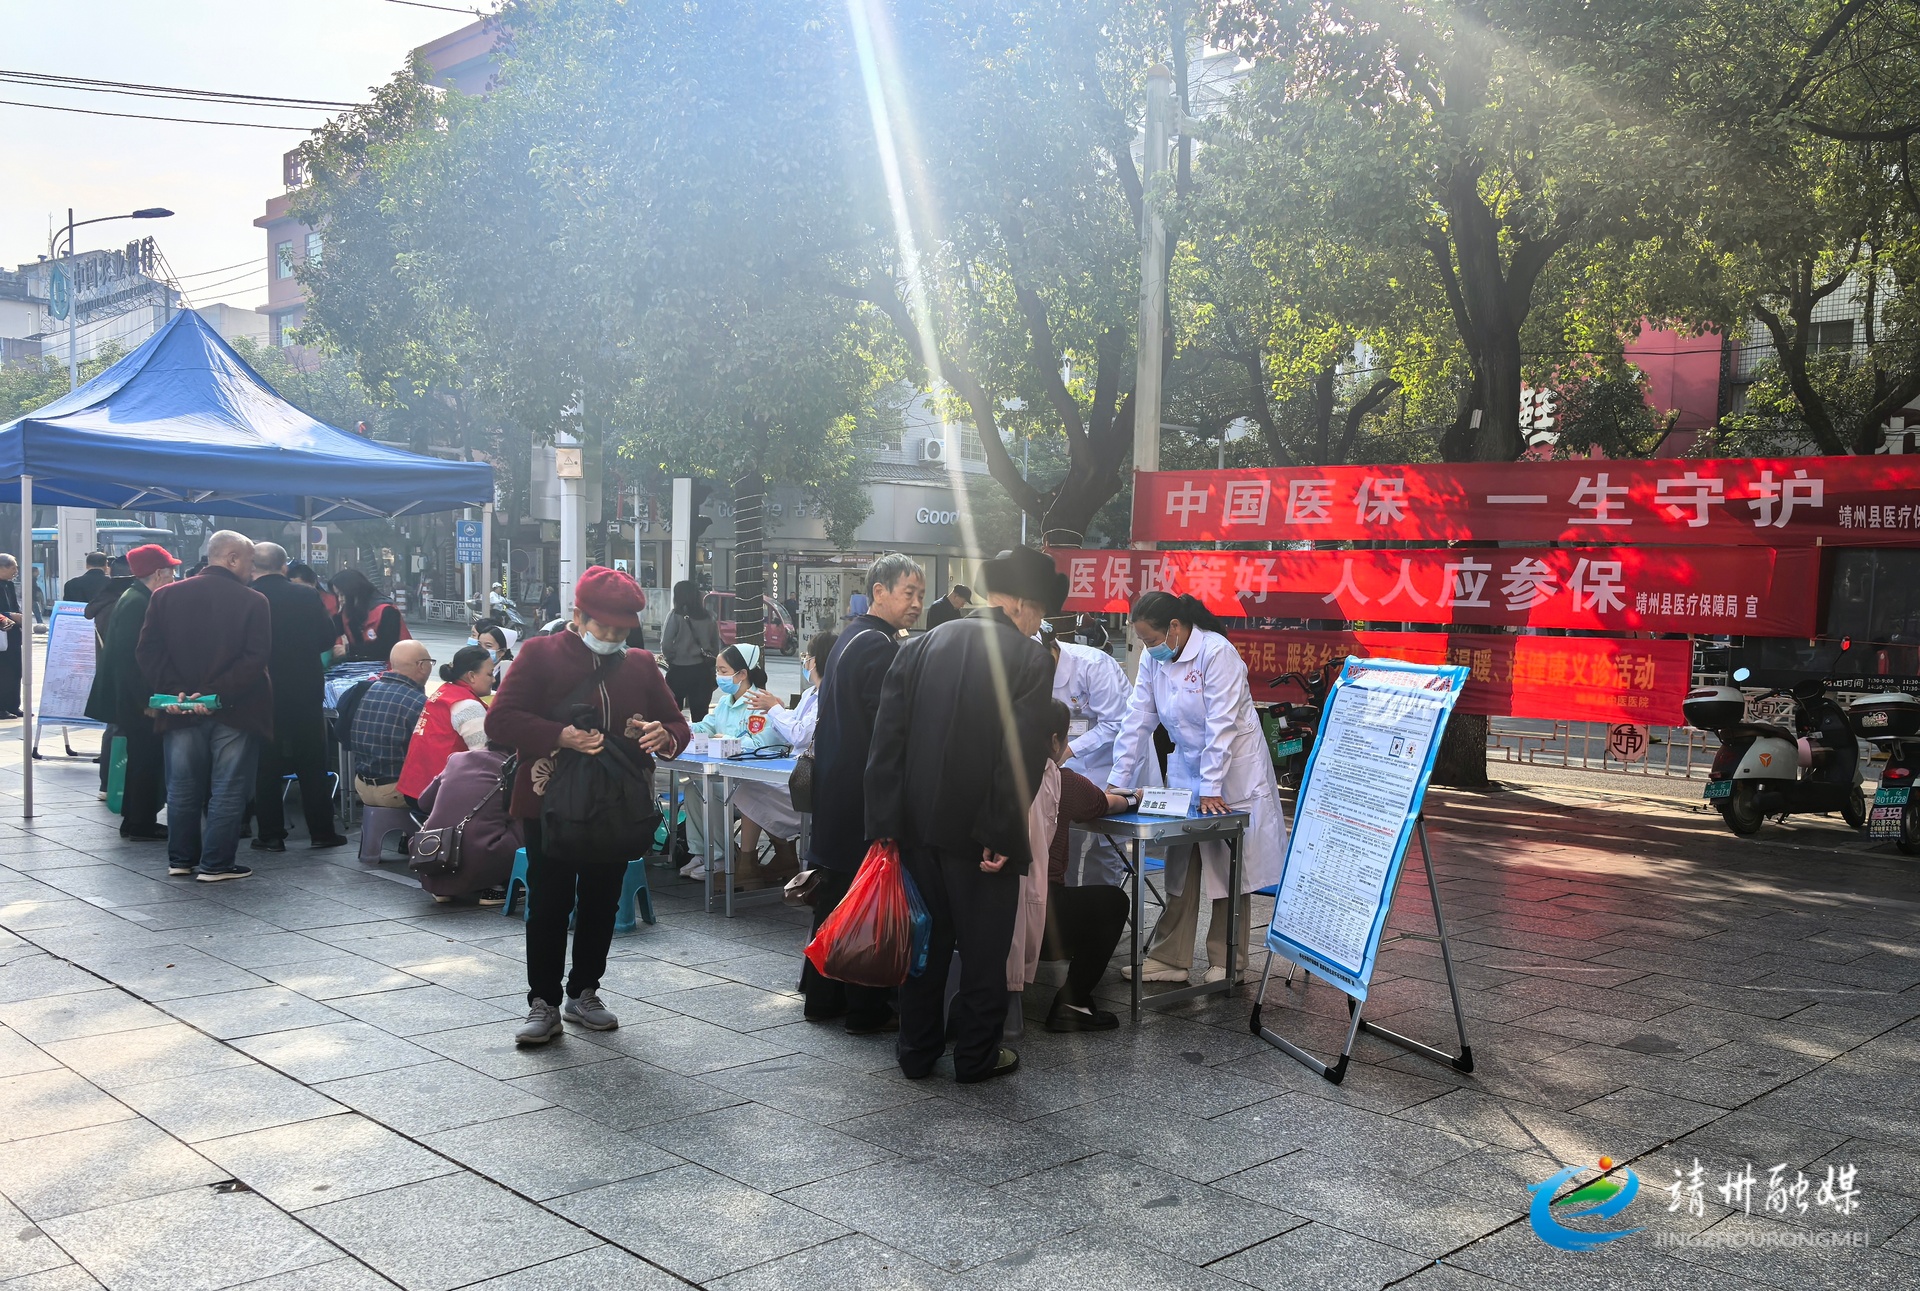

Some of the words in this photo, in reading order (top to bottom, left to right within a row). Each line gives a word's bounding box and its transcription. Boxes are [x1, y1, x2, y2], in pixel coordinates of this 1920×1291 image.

[1165, 477, 1409, 528] 中国医保
[1487, 469, 1824, 528] 一生守护
[1068, 556, 1278, 603] 医保政策好
[1322, 556, 1626, 613] 人人应参保
[1636, 592, 1738, 618] 靖州县医疗保障局
[1745, 595, 1758, 618] 宣
